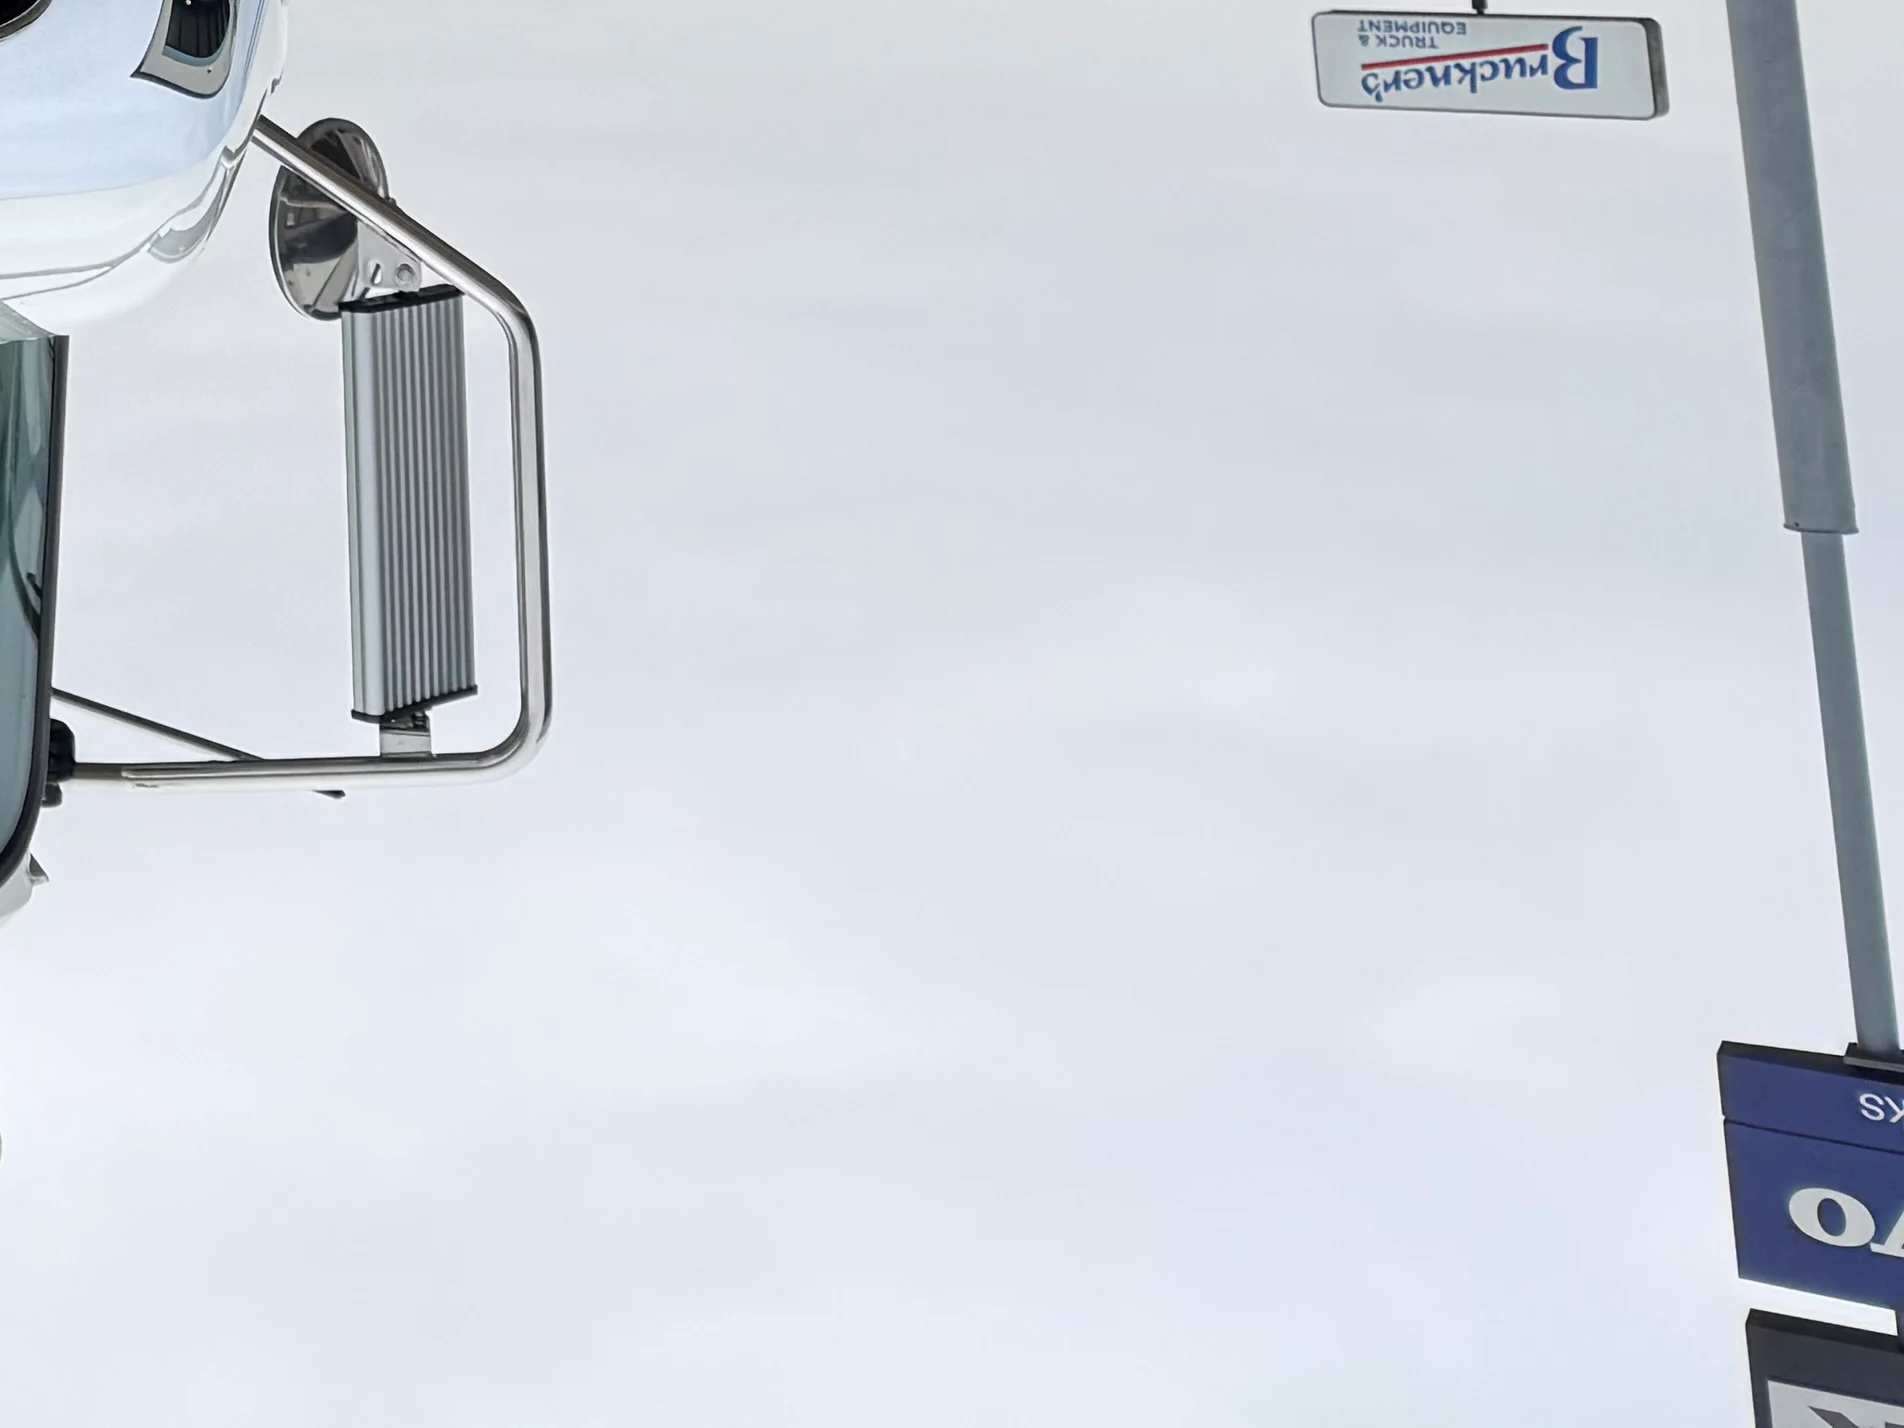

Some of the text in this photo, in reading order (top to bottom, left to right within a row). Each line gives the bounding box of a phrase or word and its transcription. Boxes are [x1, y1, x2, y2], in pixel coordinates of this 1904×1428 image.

[1357, 20, 1467, 35] EQUIPMENT
[1358, 34, 1440, 49] TRUCK &
[1360, 26, 1598, 103] Bruckner's
